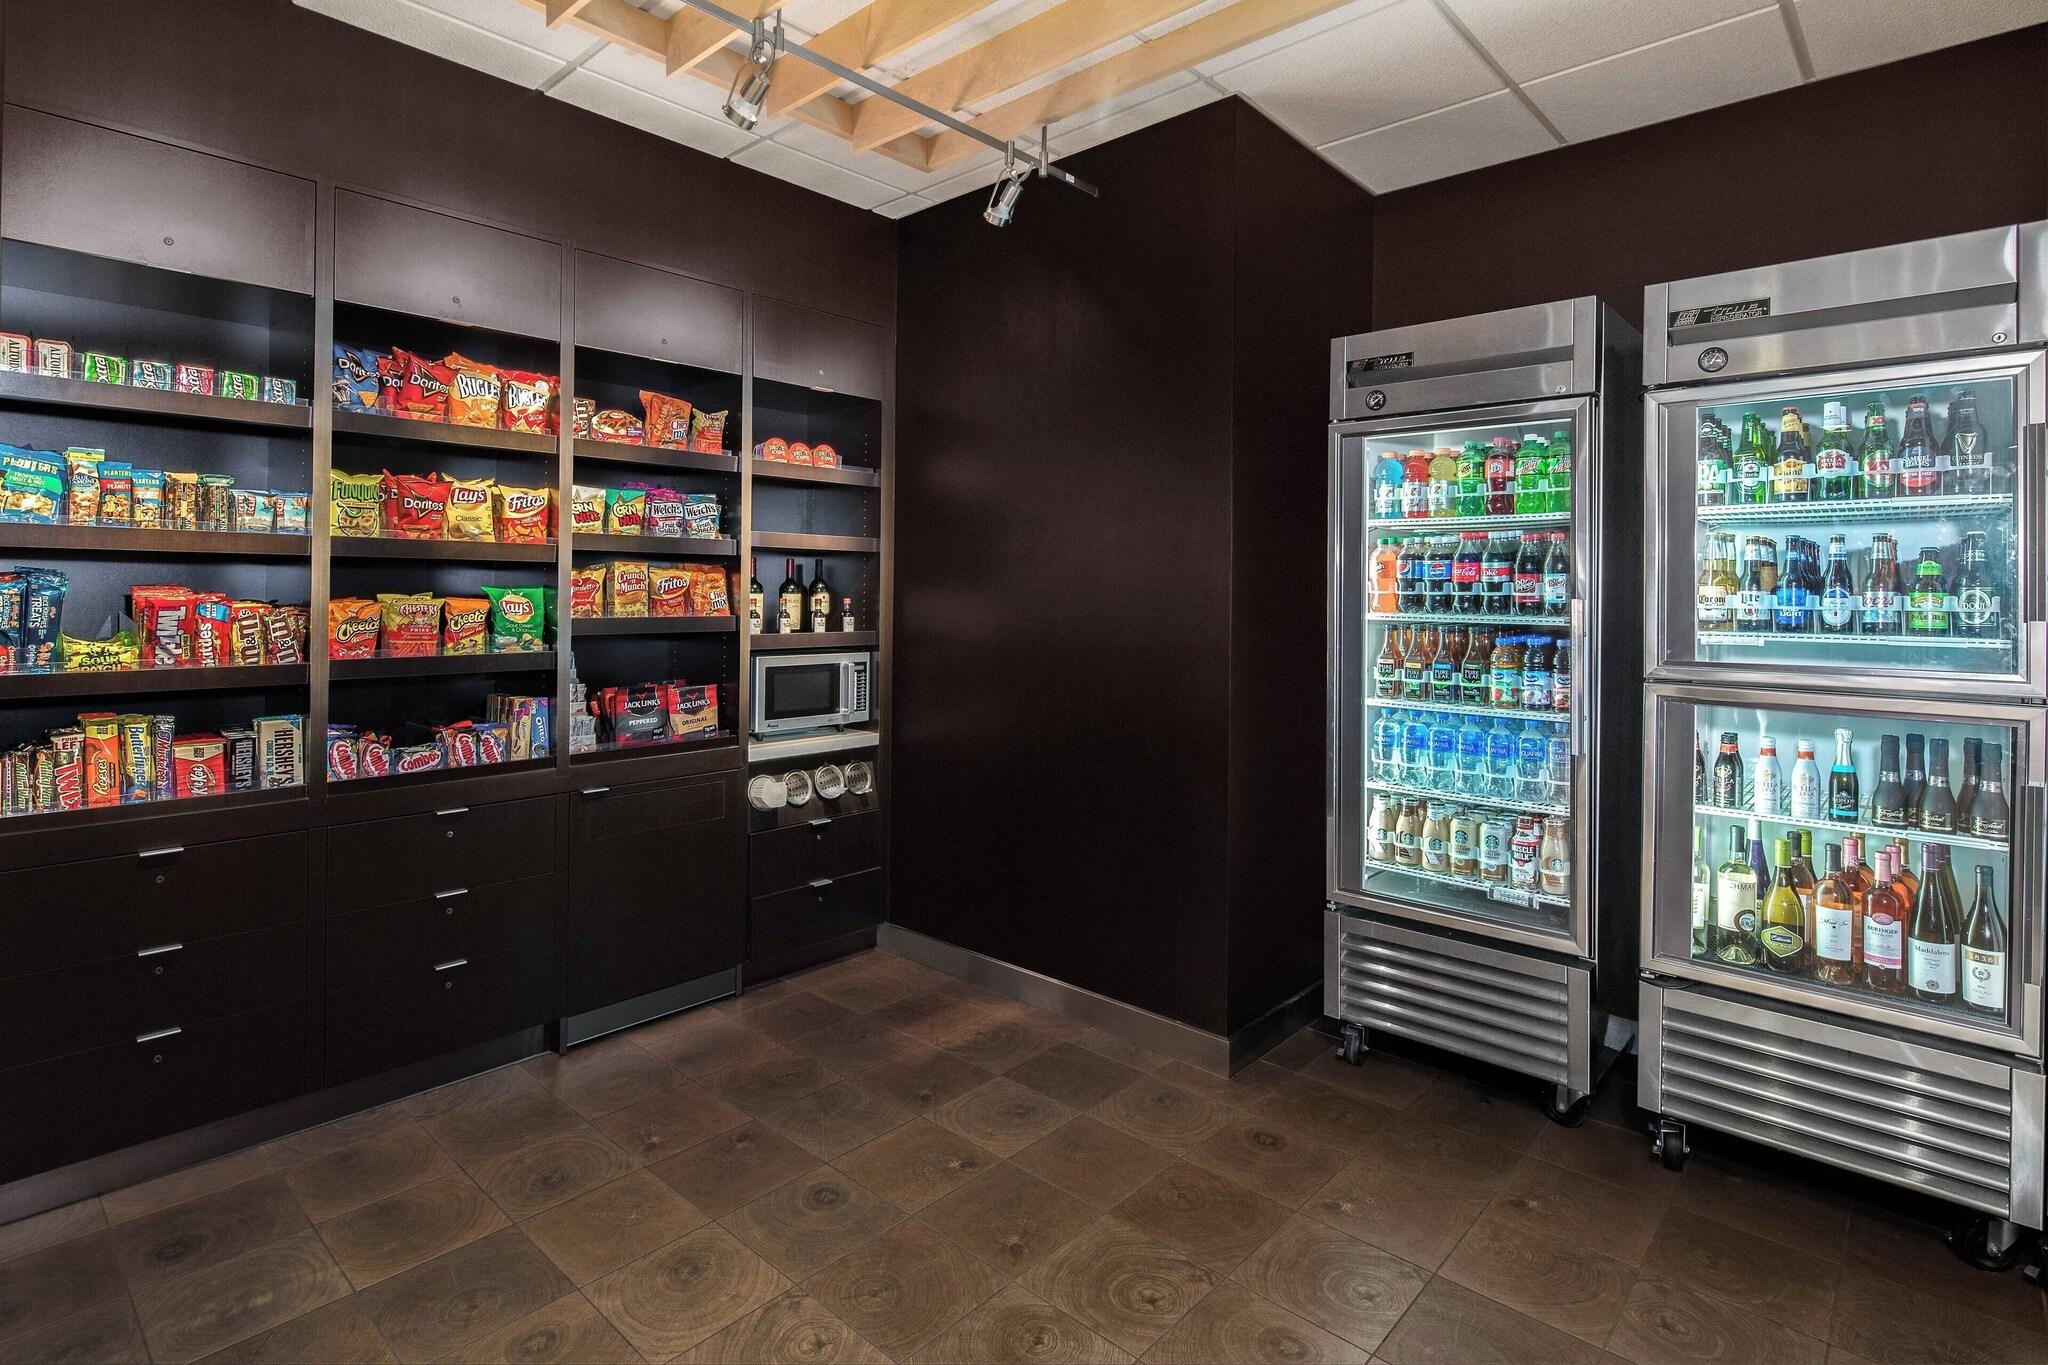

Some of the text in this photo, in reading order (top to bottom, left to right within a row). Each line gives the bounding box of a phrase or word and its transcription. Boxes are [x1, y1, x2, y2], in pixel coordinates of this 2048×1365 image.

[332, 479, 379, 502] FUNYUN
[453, 488, 486, 504] Lay's
[404, 497, 444, 512] Doritos
[509, 494, 545, 512] Fritos
[613, 501, 637, 517] CORN
[653, 503, 682, 516] Welch's
[455, 514, 482, 522] Classic
[575, 510, 601, 524] NUTS
[686, 504, 716, 518] Welch's
[618, 513, 641, 527] NUTS
[618, 570, 646, 583] Crunch
[620, 582, 646, 594] Munch
[657, 576, 688, 594] Fritos
[1698, 594, 1726, 605] Coron
[30, 597, 42, 628] TREATS
[503, 602, 530, 616] Lay's
[449, 609, 487, 632] Cheeto
[81, 655, 121, 666] SOUR
[624, 699, 641, 710] JACK
[676, 701, 694, 711] JACK
[628, 717, 658, 726] PEPPERED
[681, 716, 708, 726] ORIGINAL
[55, 741, 83, 751] LEFT
[129, 726, 148, 786] Butterfinger
[401, 752, 440, 772] Combos
[156, 738, 170, 790] Musketeers
[1914, 945, 1950, 956] Maddalena
[1968, 952, 1994, 963] 1836
